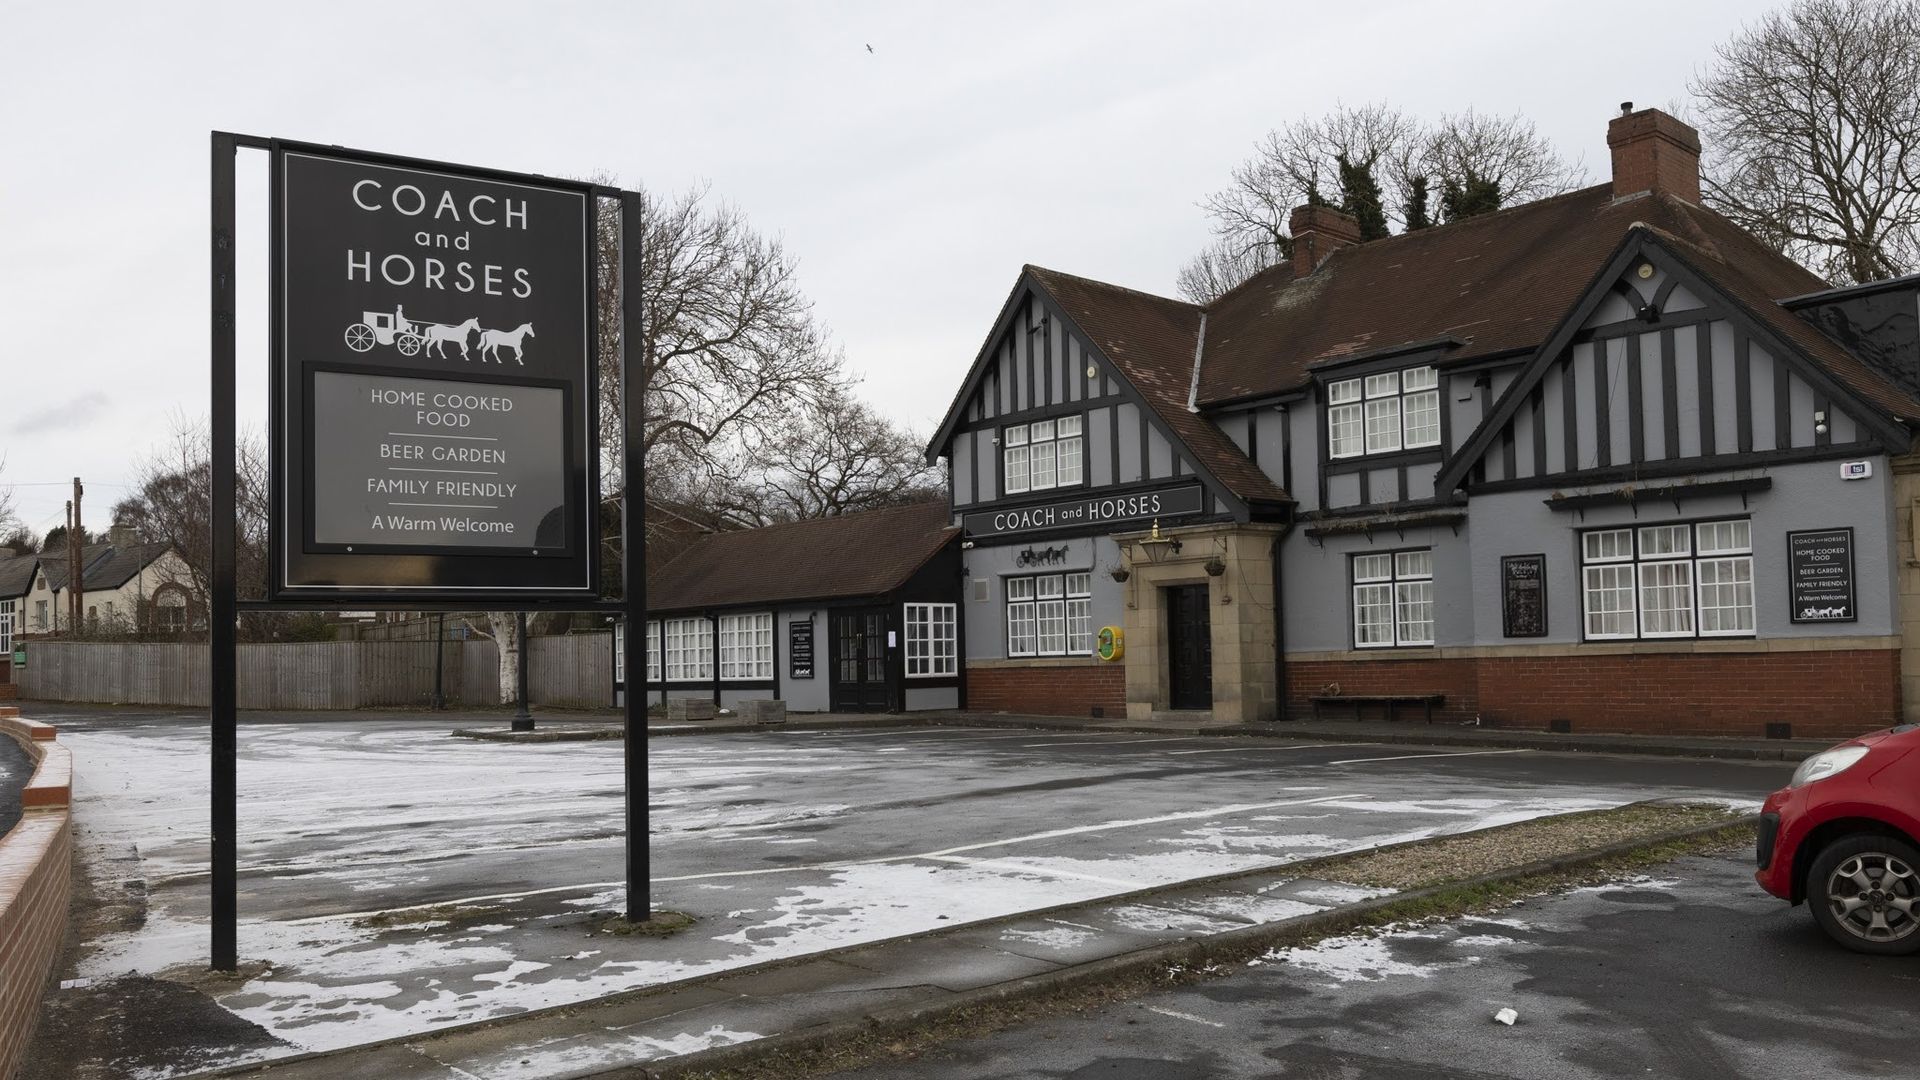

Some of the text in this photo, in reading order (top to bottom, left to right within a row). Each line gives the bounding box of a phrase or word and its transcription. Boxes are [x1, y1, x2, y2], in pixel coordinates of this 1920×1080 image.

[352, 179, 528, 230] COACH
[414, 231, 470, 251] and
[347, 249, 532, 299] HORSES
[371, 389, 513, 412] HOME COOKED
[417, 411, 471, 427] FOOD
[380, 444, 506, 464] BEER GARDEN
[367, 478, 517, 498] FAMILY FRIENDLY
[994, 494, 1161, 531] COACH and HORSES
[371, 515, 514, 533] A Warm Welcome
[1816, 547, 1845, 555] COOKED
